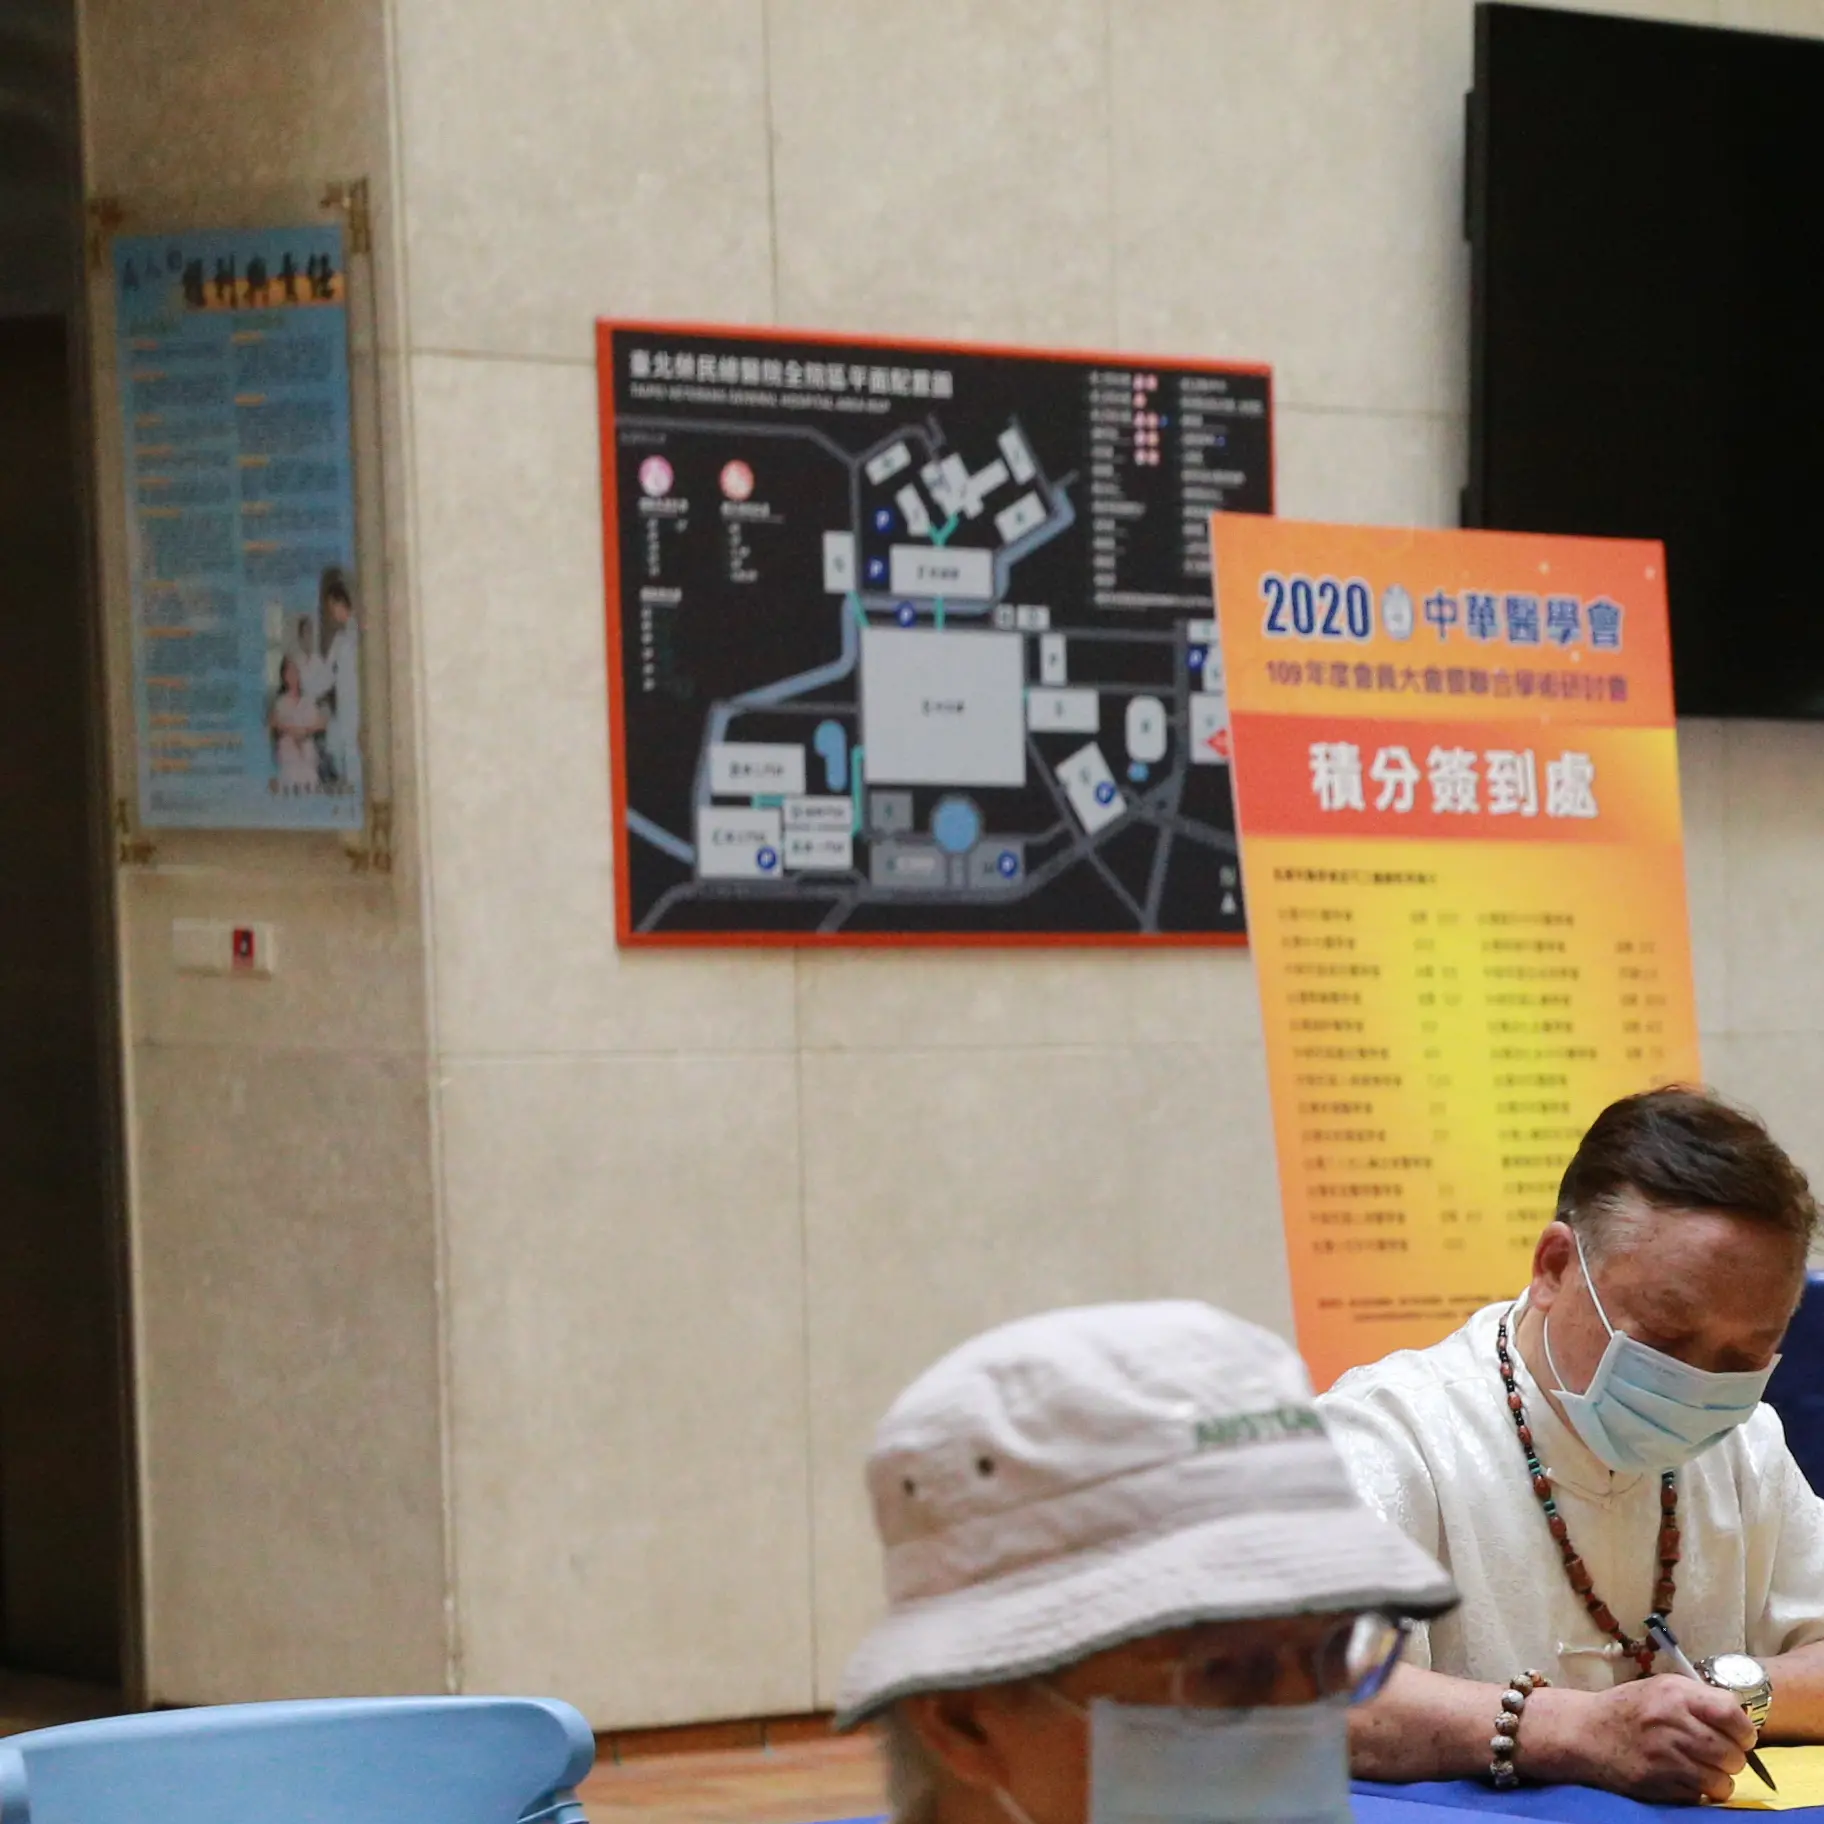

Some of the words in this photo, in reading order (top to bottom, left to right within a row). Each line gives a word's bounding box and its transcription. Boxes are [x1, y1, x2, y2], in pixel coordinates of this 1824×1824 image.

[1262, 577, 1371, 640] 2020
[1423, 590, 1624, 649] 中華醫學會
[1309, 741, 1598, 817] 積分簽到處
